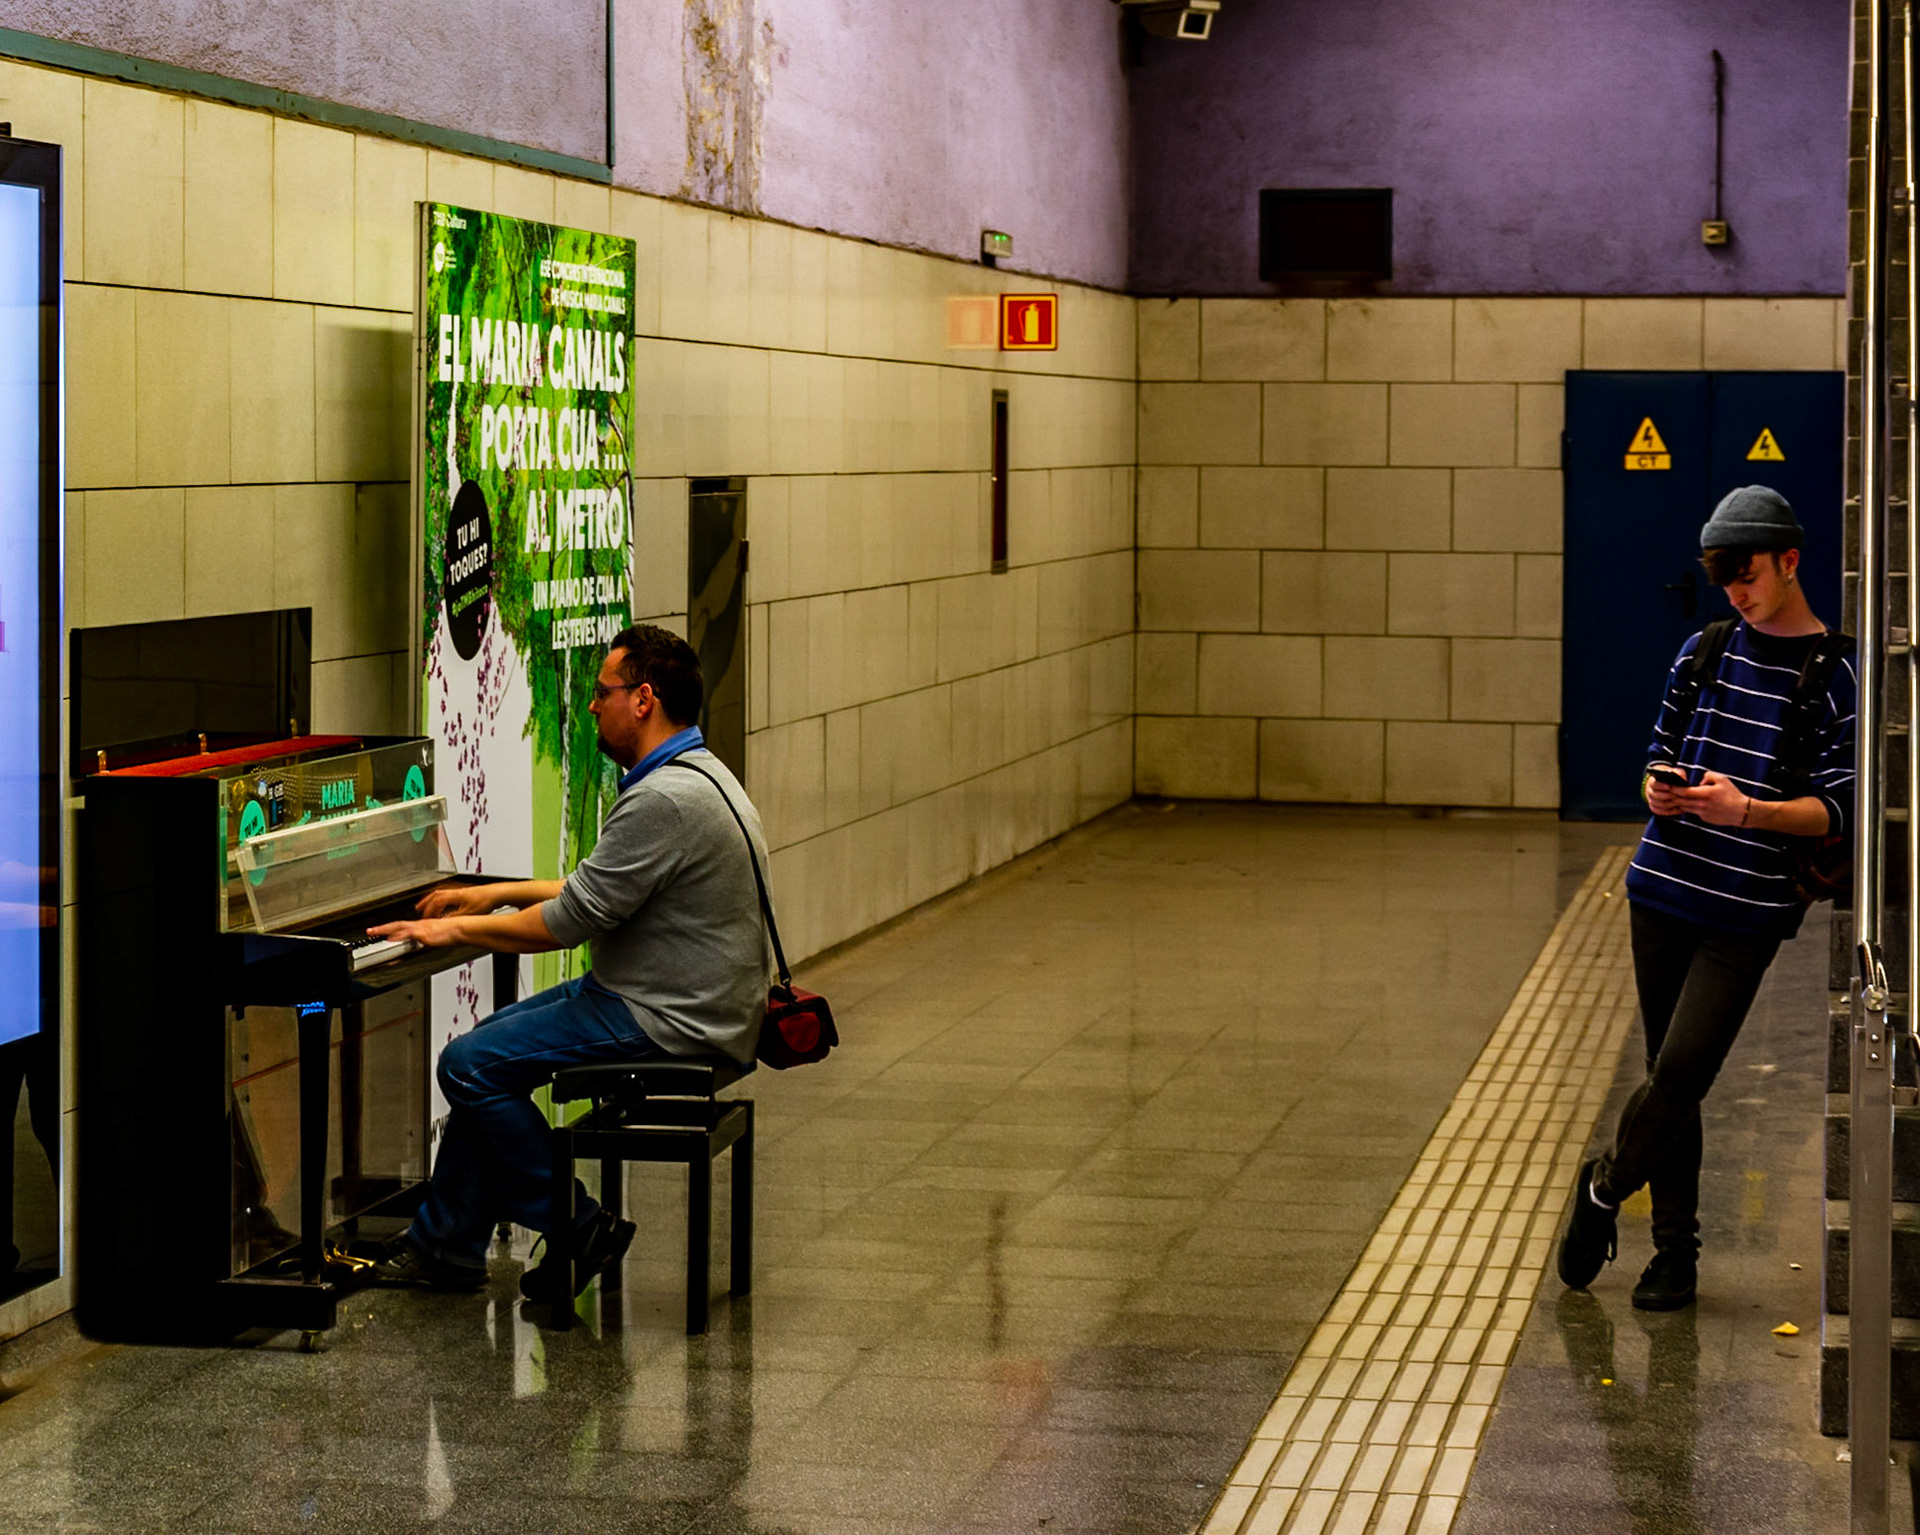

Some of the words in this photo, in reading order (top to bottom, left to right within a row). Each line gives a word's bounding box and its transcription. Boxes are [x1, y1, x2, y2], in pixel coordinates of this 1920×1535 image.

[581, 264, 625, 288] INTERNACIONAL
[551, 287, 559, 306] DE
[584, 292, 602, 311] MARIA
[604, 294, 626, 315] CANALS
[439, 314, 465, 383] EL
[471, 316, 543, 388] MARIA
[549, 324, 625, 394] CANALS
[481, 403, 550, 472] PORTA
[557, 406, 599, 471] CUA
[1637, 456, 1658, 468] CT
[457, 524, 468, 550] TU
[469, 516, 480, 542] HI
[524, 490, 550, 553] AL
[556, 486, 624, 551] METRO
[450, 542, 488, 586] TOQUES?
[533, 580, 548, 611] UN
[550, 577, 580, 609] PIANO
[582, 576, 595, 606] DE
[596, 575, 615, 605] CUA
[616, 575, 624, 603] A
[552, 619, 568, 650] LES
[569, 616, 597, 647] TEVES
[322, 779, 355, 811] MARIA
